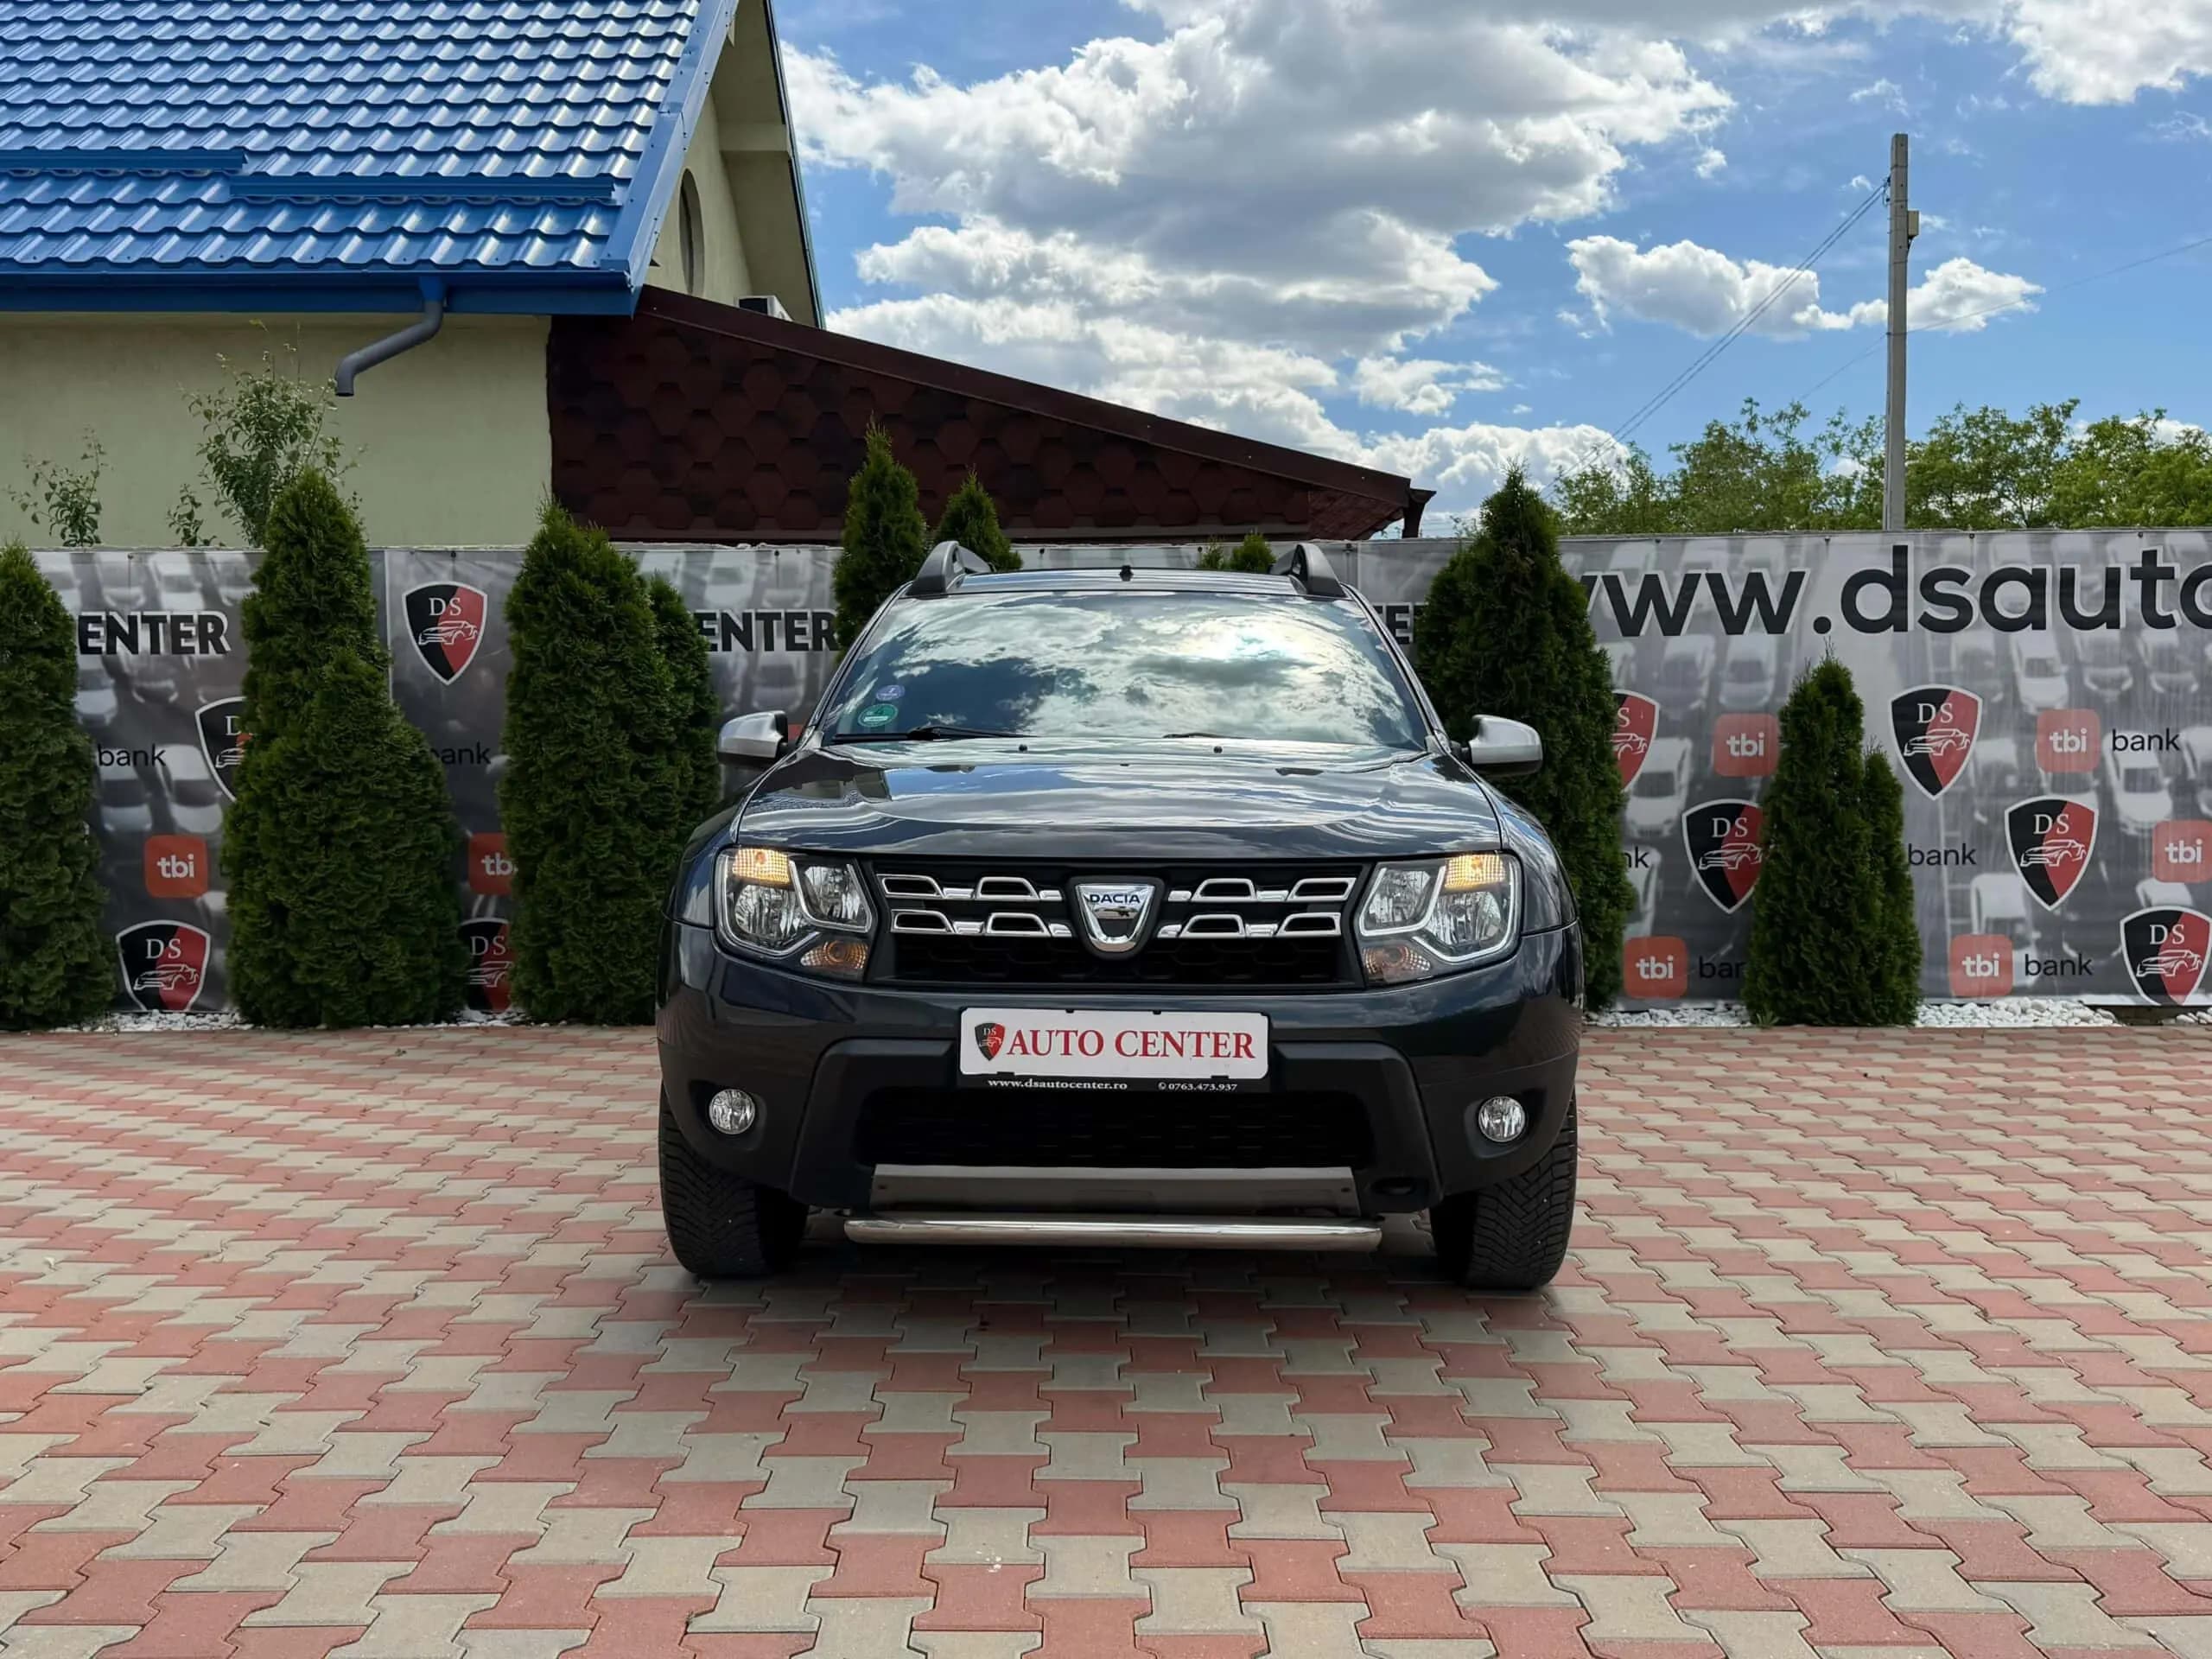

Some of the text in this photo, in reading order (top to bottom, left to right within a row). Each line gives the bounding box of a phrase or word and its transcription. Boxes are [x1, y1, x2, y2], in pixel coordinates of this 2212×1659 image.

[429, 597, 462, 616] DS
[1916, 702, 1954, 724] DS
[1726, 732, 1765, 757] tbi
[2049, 728, 2180, 753] tbi bank
[97, 744, 166, 767] bank
[1712, 817, 1748, 838] DS
[2033, 813, 2069, 835] DS
[1907, 843, 1977, 867] bank
[2164, 839, 2202, 864] tbi
[157, 854, 194, 879] tbi
[480, 852, 518, 876] tb
[1090, 893, 1141, 904] DACIA
[470, 935, 506, 957] DS
[2149, 924, 2186, 945] DS
[145, 938, 181, 959] DS
[1636, 955, 1675, 980] tbi
[1961, 953, 2093, 978] tbi bank
[983, 1027, 1256, 1059] DS AUTO CENTER
[988, 1078, 1128, 1090] www.dsautocenter.ro
